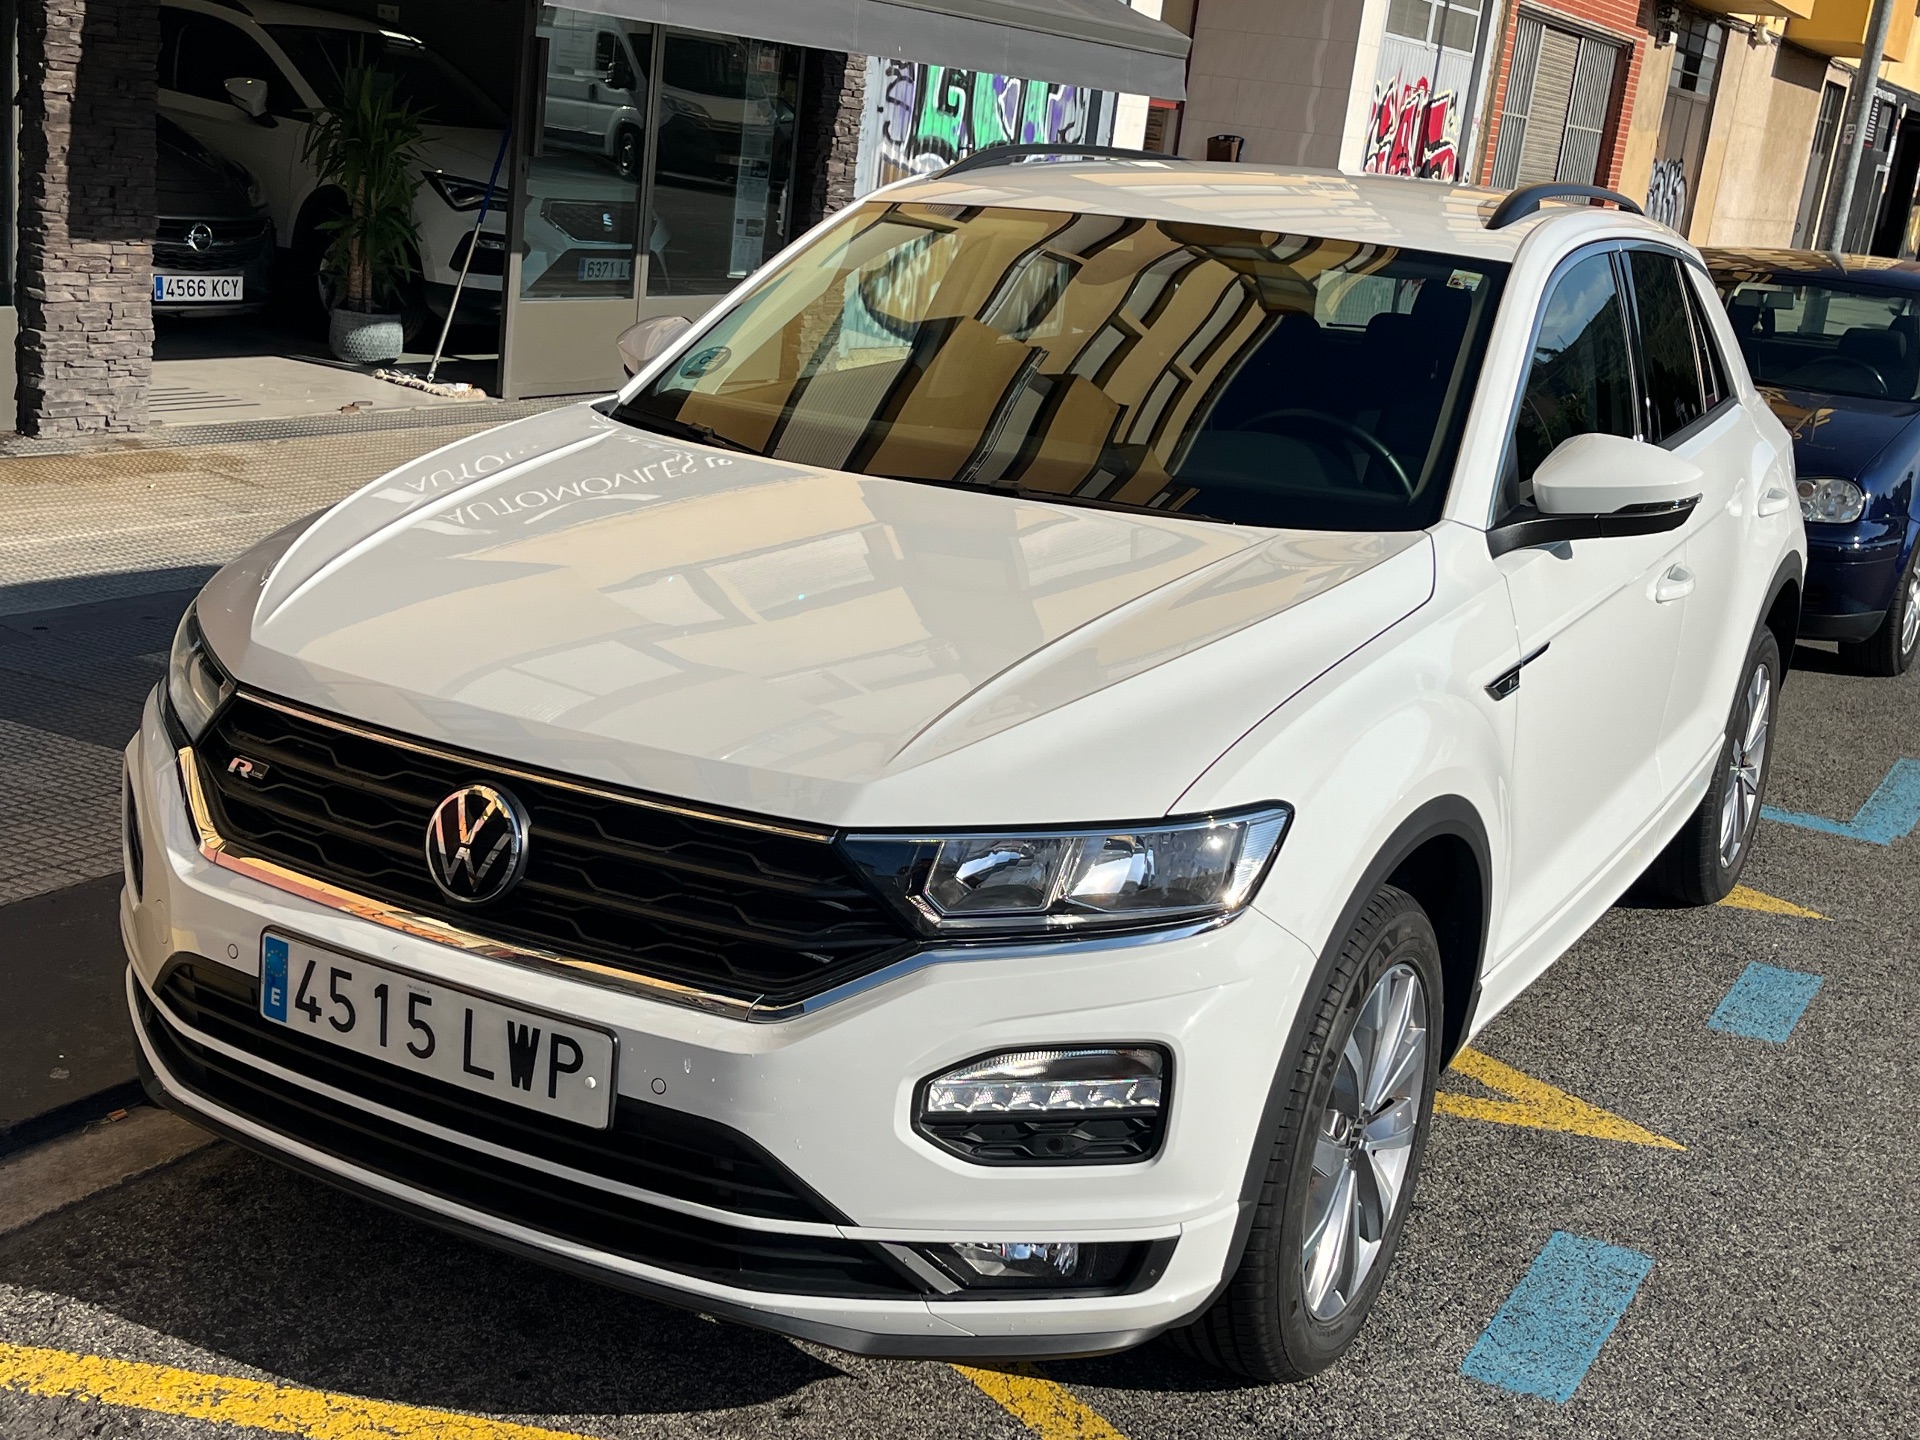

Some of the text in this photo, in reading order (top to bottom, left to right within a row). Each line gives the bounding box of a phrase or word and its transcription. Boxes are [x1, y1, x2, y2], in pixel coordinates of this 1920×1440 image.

[587, 261, 615, 278] 6371
[166, 279, 206, 297] 4566
[211, 279, 239, 297] KCY
[270, 959, 584, 1099] E 4515 LWP
